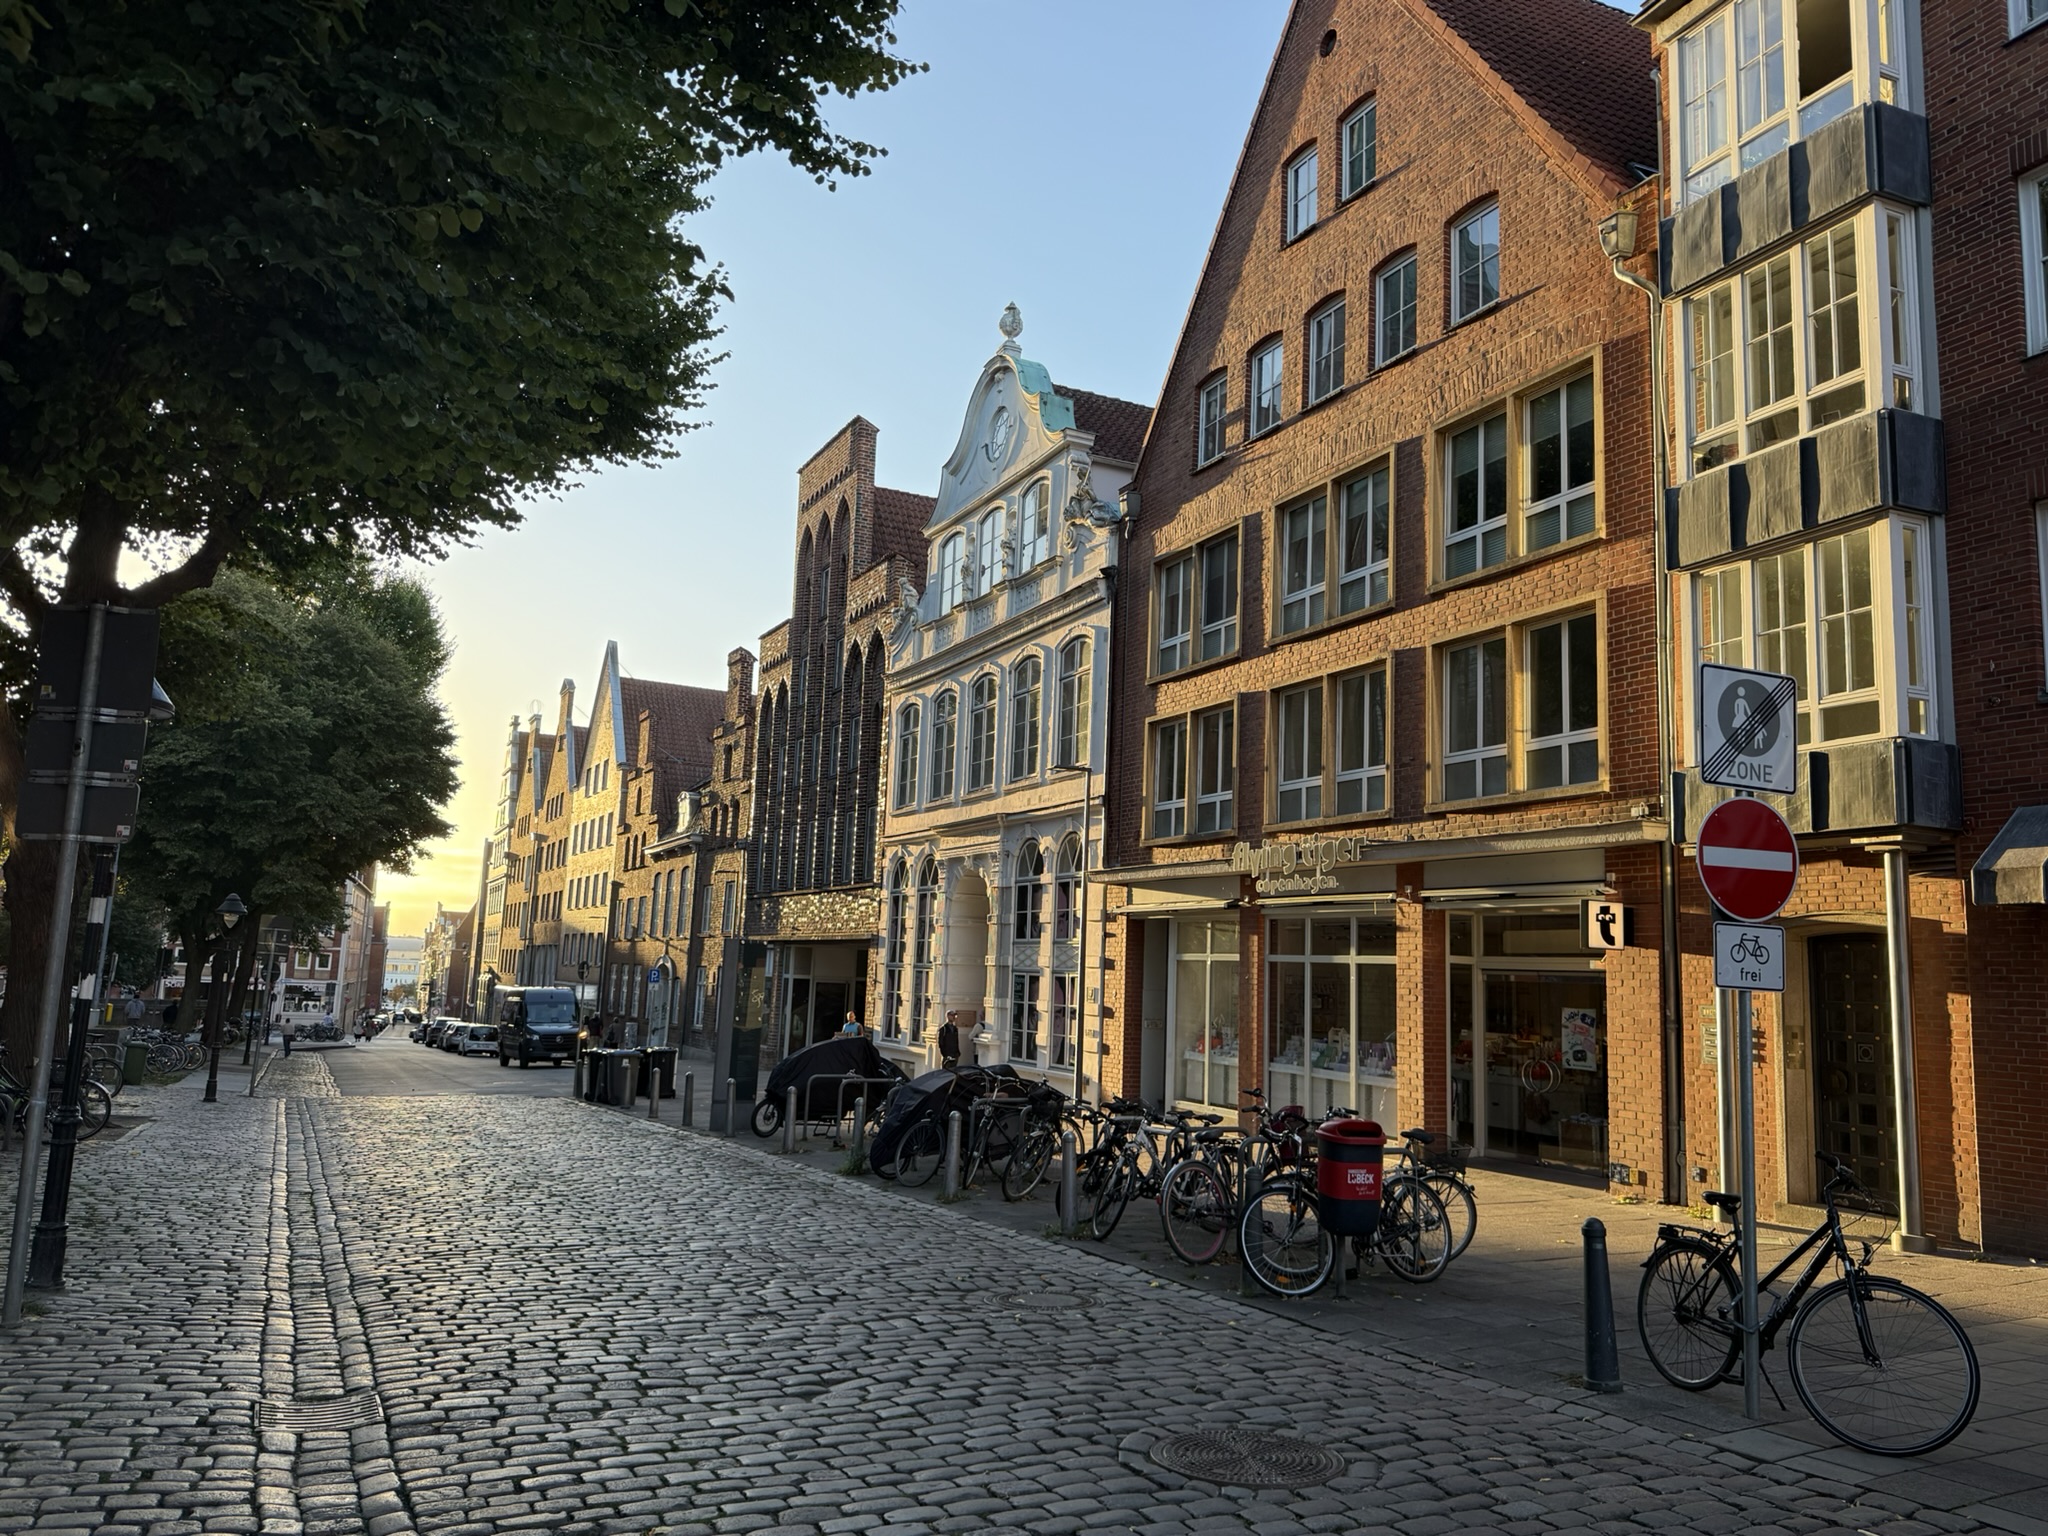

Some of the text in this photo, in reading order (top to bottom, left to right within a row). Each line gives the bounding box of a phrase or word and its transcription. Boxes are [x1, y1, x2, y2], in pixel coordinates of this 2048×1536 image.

[1727, 760, 1773, 784] ZONE
[1232, 832, 1367, 877] flying tiger
[1740, 967, 1762, 982] frei
